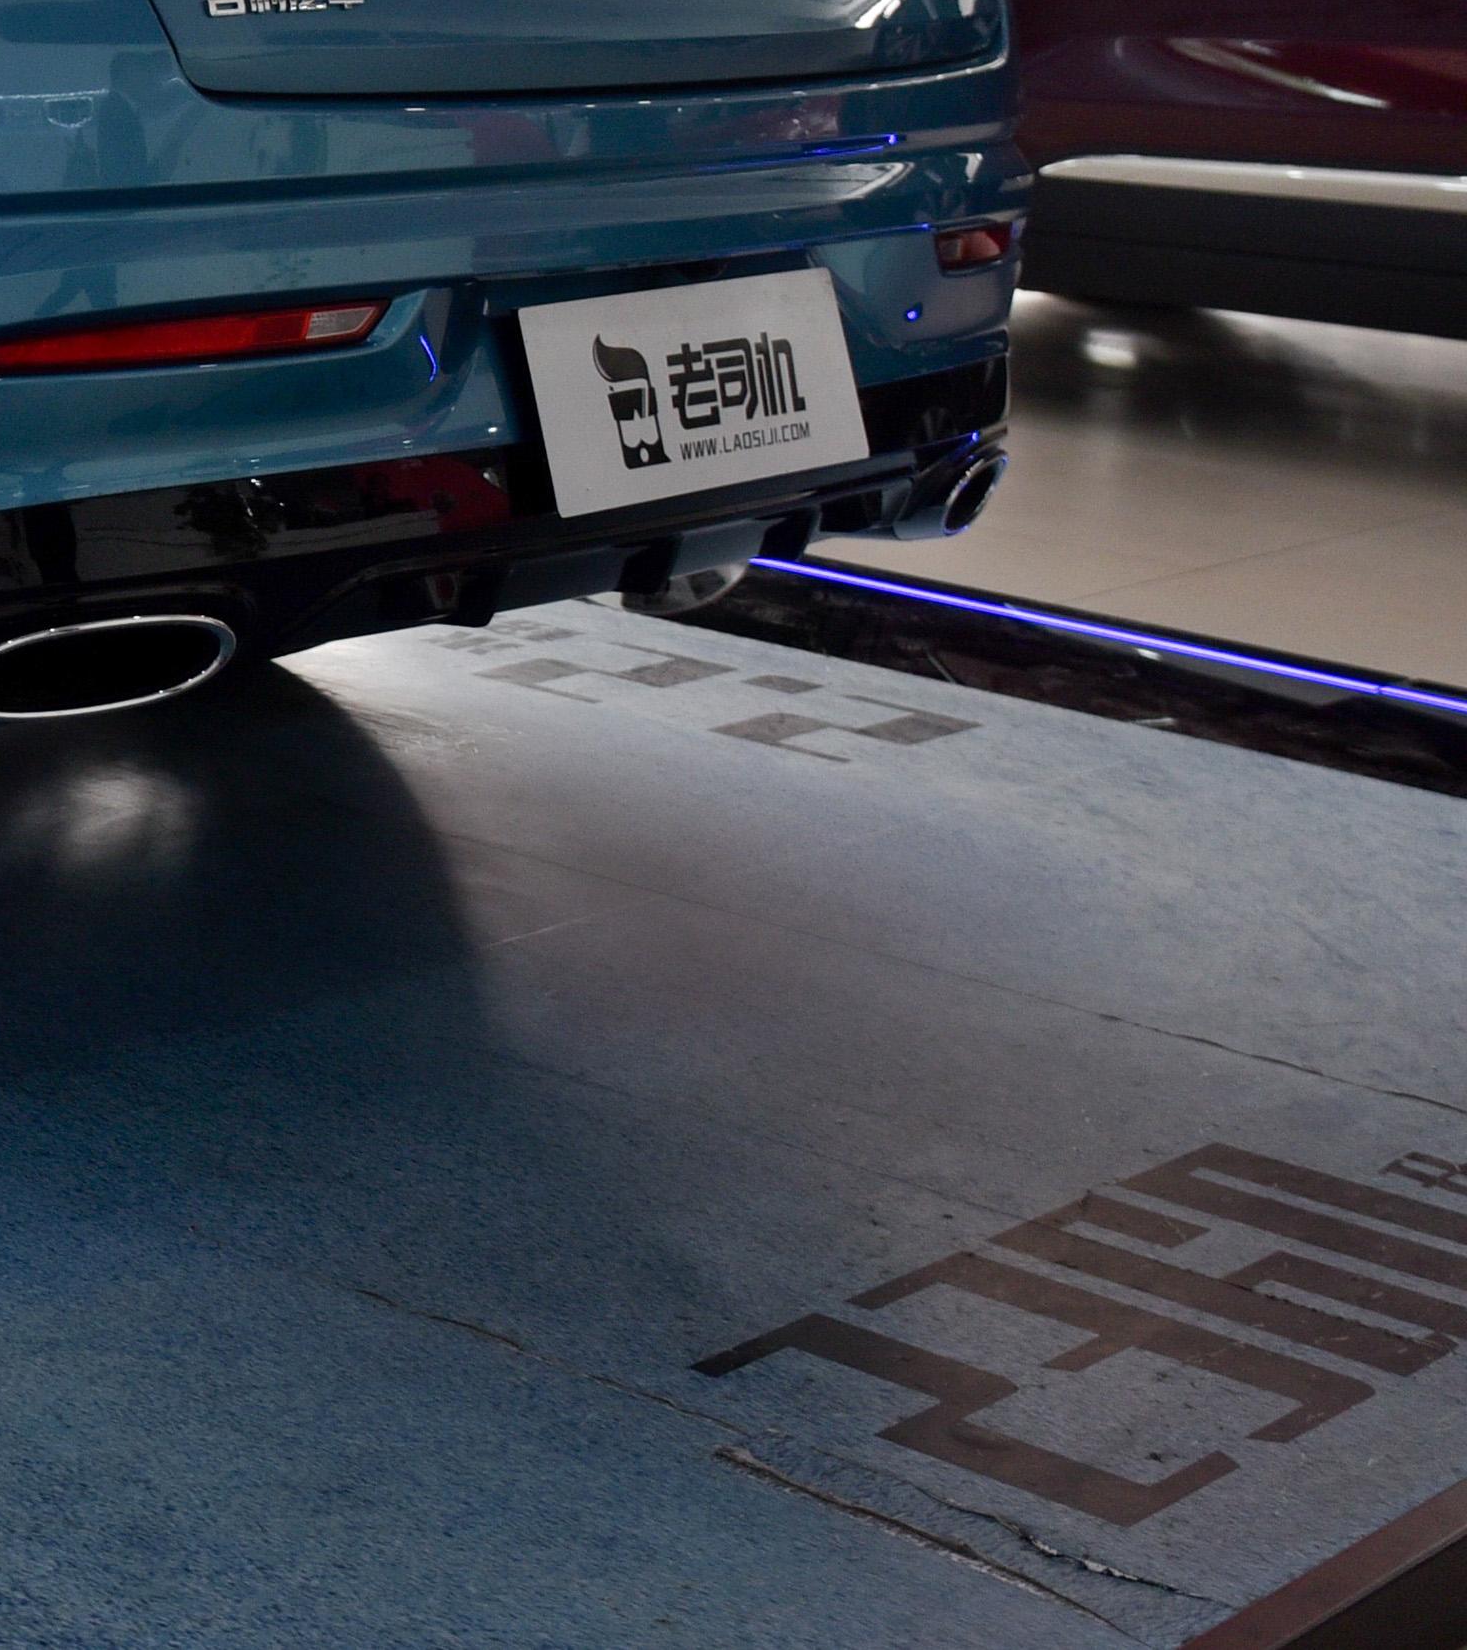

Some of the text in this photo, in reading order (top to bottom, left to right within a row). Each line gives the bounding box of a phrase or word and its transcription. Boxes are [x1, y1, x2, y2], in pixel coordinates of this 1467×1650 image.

[666, 332, 807, 430] 老司机
[679, 421, 812, 462] WWW.LAOSIJI.COM
